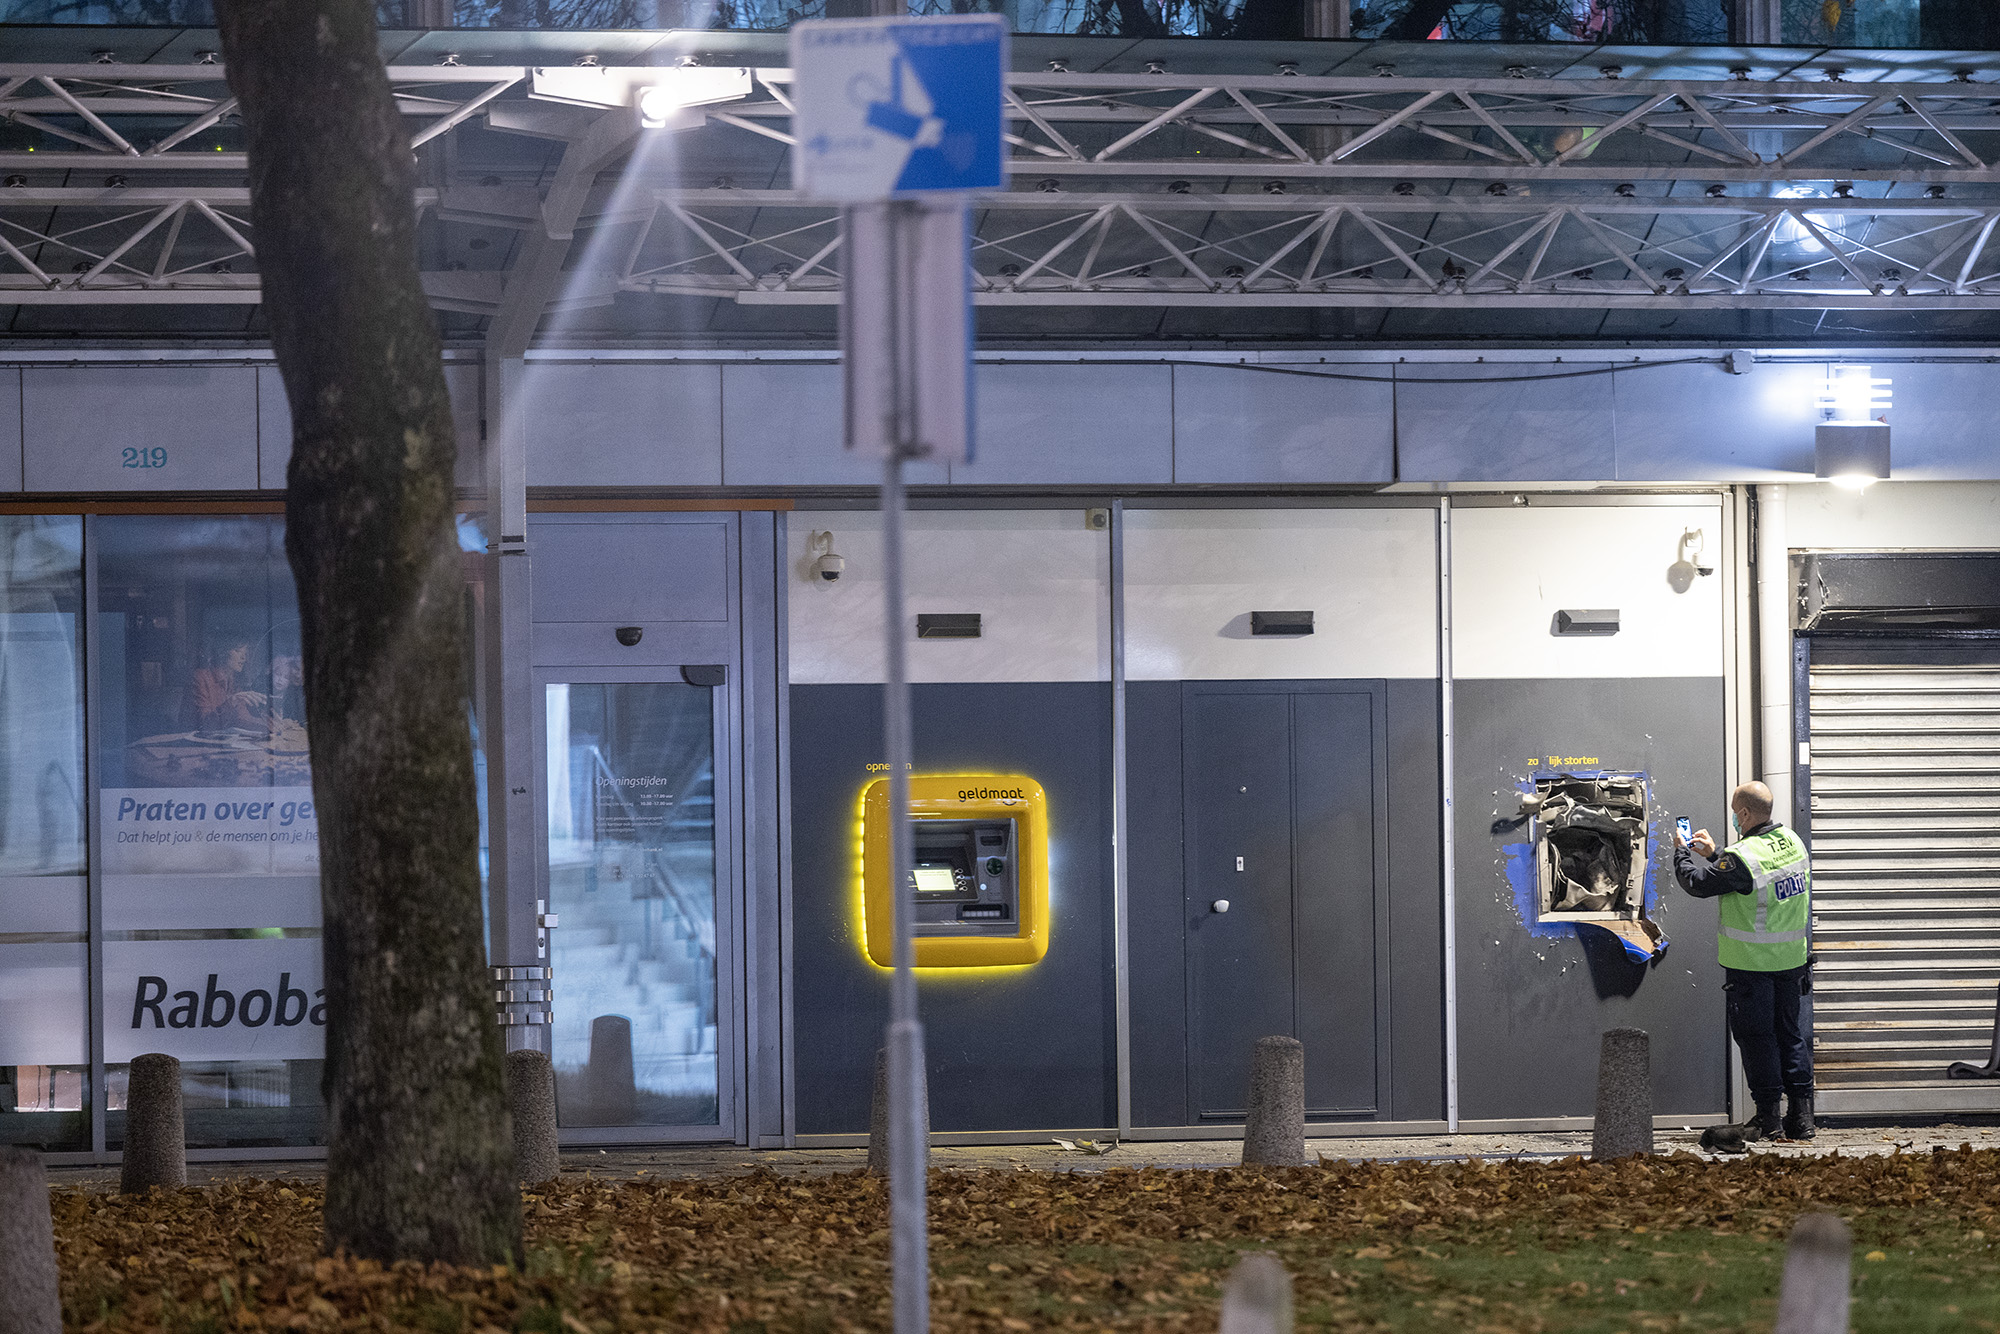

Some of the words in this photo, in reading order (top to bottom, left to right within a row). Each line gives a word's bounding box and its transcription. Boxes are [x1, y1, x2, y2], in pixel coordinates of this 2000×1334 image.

[121, 446, 168, 469] 219
[865, 762, 912, 773] opnen
[1563, 755, 1599, 765] storten
[595, 775, 668, 789] Openingstijden
[958, 787, 1025, 803] geldmaat
[117, 796, 207, 821] Praten
[213, 801, 275, 821] over
[117, 831, 140, 844] Dat
[141, 830, 171, 846] helpt
[171, 830, 192, 846] jou
[205, 830, 221, 843] de
[222, 832, 268, 842] mensen
[270, 831, 290, 842] om
[290, 829, 302, 844] je
[304, 828, 319, 841] he
[131, 972, 327, 1029] Raboba
